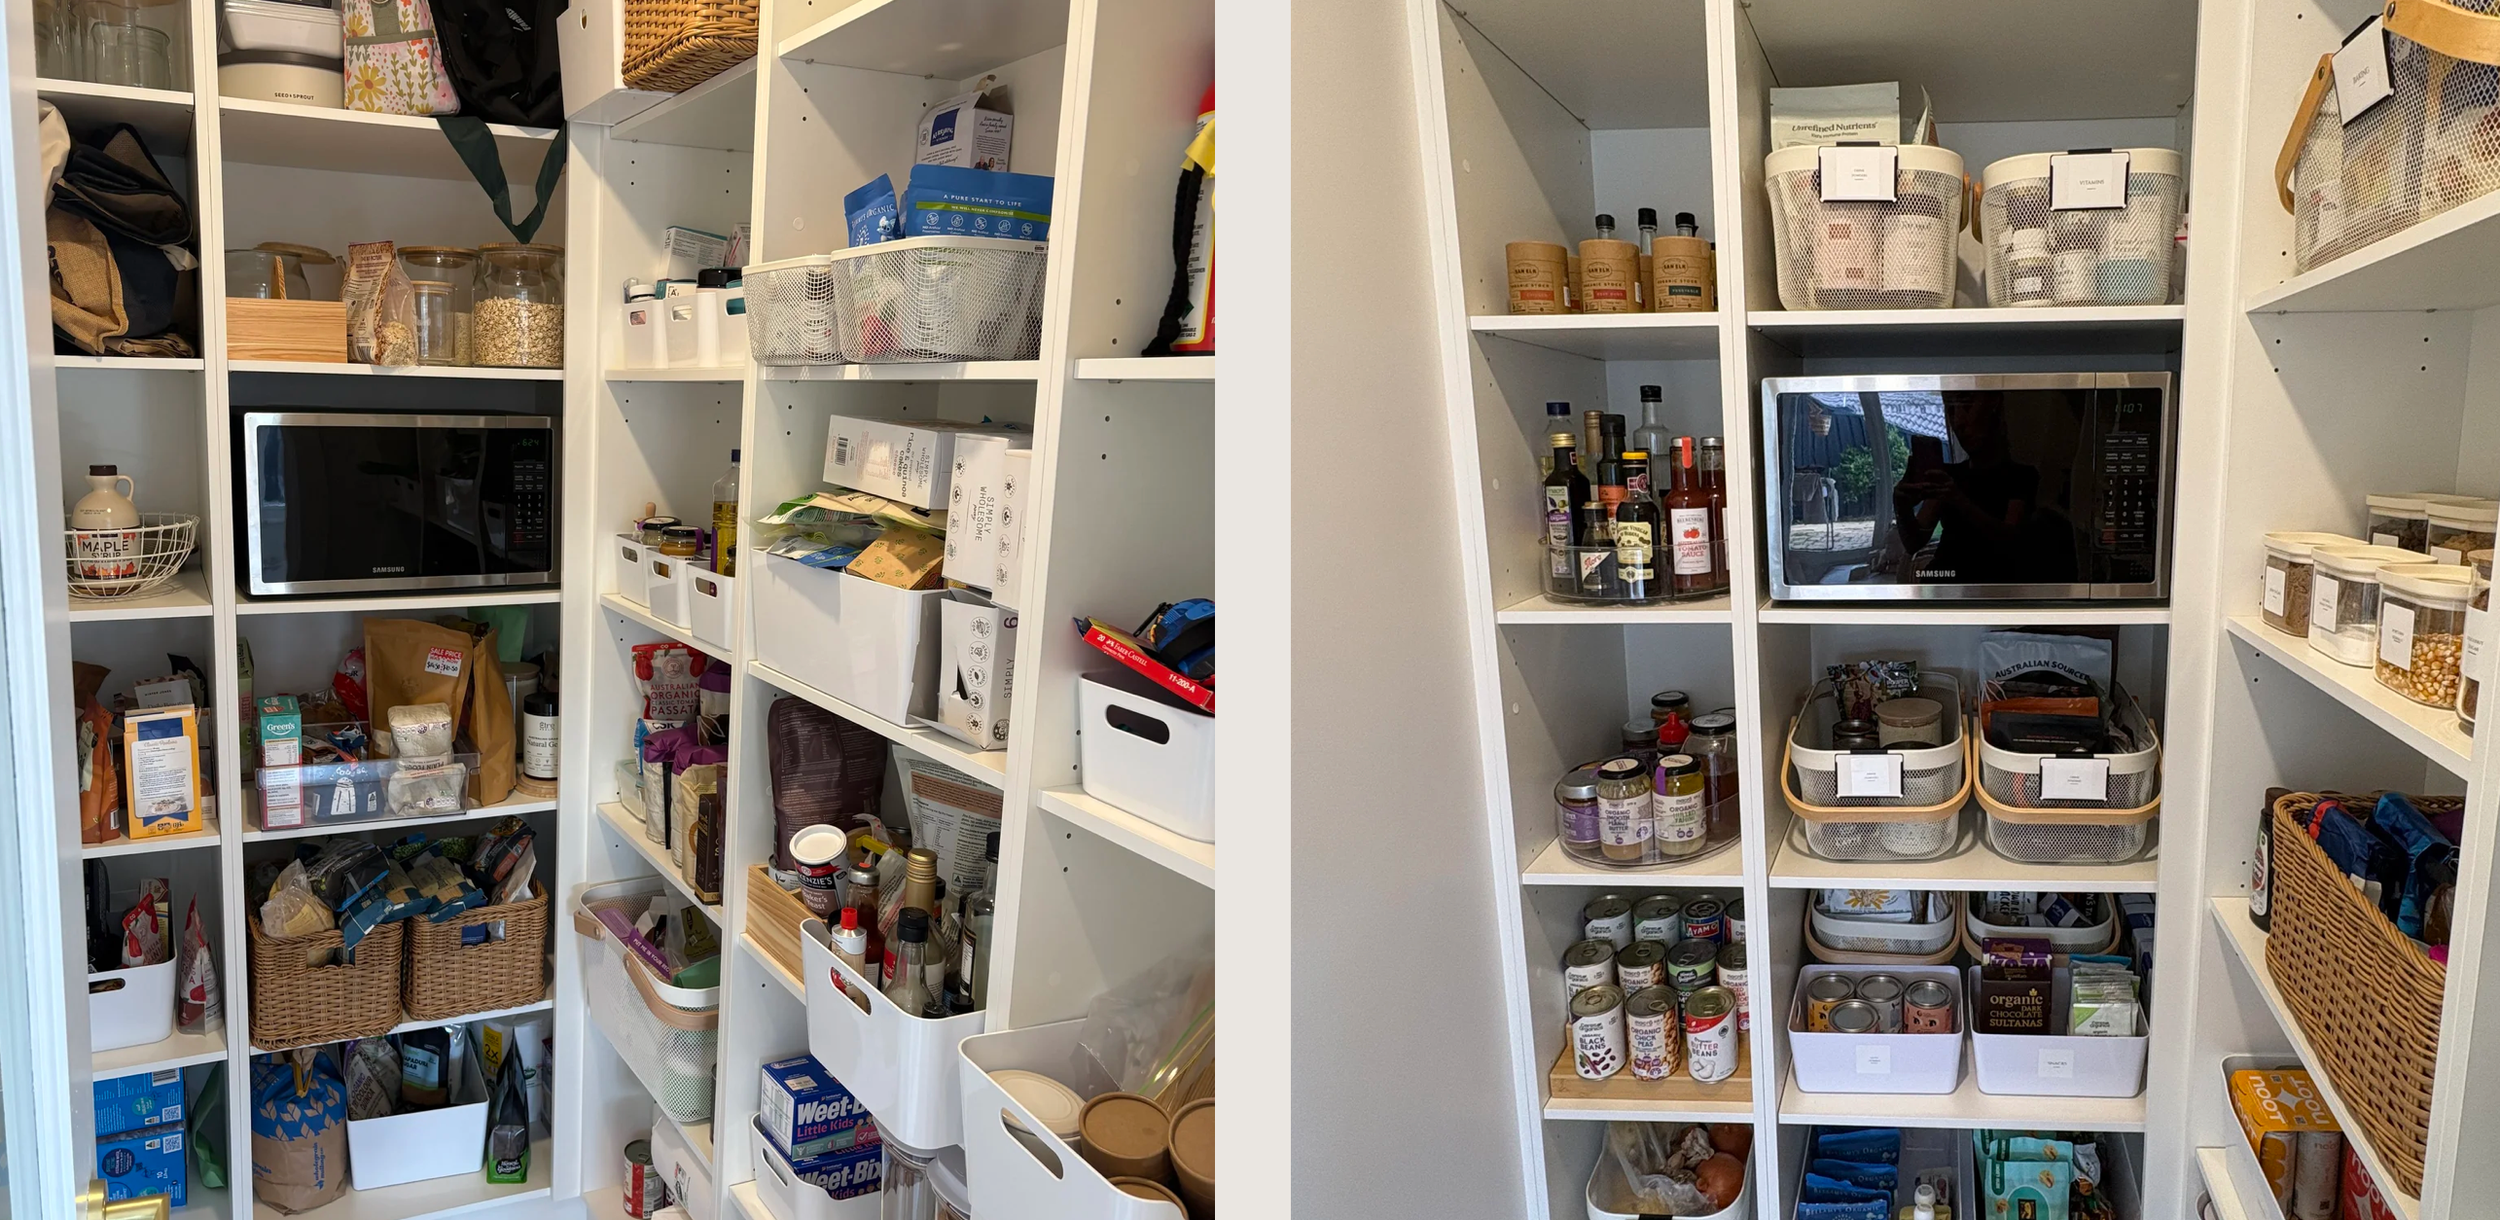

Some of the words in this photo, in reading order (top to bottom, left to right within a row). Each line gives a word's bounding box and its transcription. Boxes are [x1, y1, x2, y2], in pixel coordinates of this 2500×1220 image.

[1792, 124, 1835, 133] Unrefined
[1836, 122, 1878, 132] Nutrients
[867, 204, 894, 218] ORGANIC
[906, 432, 915, 454] rice
[897, 450, 905, 478] cakes
[918, 447, 926, 490] WHOLESOME
[975, 486, 988, 542] WHOLESOME
[986, 497, 995, 534] SIMPLY
[1629, 525, 1649, 535] VINEGAR
[82, 540, 129, 552] MAPLE
[372, 566, 405, 574] SAMSUNG
[1916, 570, 1956, 578] SAMSUNG
[1097, 634, 1106, 642] 20
[430, 648, 444, 656] SALE
[445, 651, 462, 659] PRICE
[1102, 644, 1118, 656] Connector
[1117, 651, 1126, 660] Pens
[1995, 660, 2050, 679] AUSTRALIAN
[1004, 658, 1015, 698] SIMPLY
[1168, 673, 1196, 694] 11-200-A
[650, 682, 700, 691] AUSTRALIAN
[650, 690, 701, 700] ORGANIC
[267, 722, 296, 731] Green's
[527, 739, 547, 748] Natural
[1669, 804, 1698, 813] ORGANIC
[632, 938, 641, 947] PUT
[651, 953, 662, 966] YOUR
[1990, 993, 2043, 1008] organic
[1990, 1011, 2043, 1019] CHOCOLATE
[1990, 1019, 2043, 1027] SULTANAS
[1631, 1027, 1661, 1035] ORGANIC
[1691, 1042, 1718, 1050] BUTTER
[485, 1044, 498, 1061] 2X
[1692, 1049, 1718, 1057] BEANS
[356, 1076, 373, 1099] COLOUR
[360, 1089, 376, 1111] QUINOA
[797, 1096, 870, 1126] Weet-B
[797, 1125, 828, 1138] Little
[830, 1119, 854, 1130] Kids
[1863, 1144, 1896, 1154] ORGANIC
[797, 1158, 882, 1191] Weet-Bix
[832, 1190, 855, 1200] Kids
[1806, 1208, 1844, 1216] BELLAMY'S
